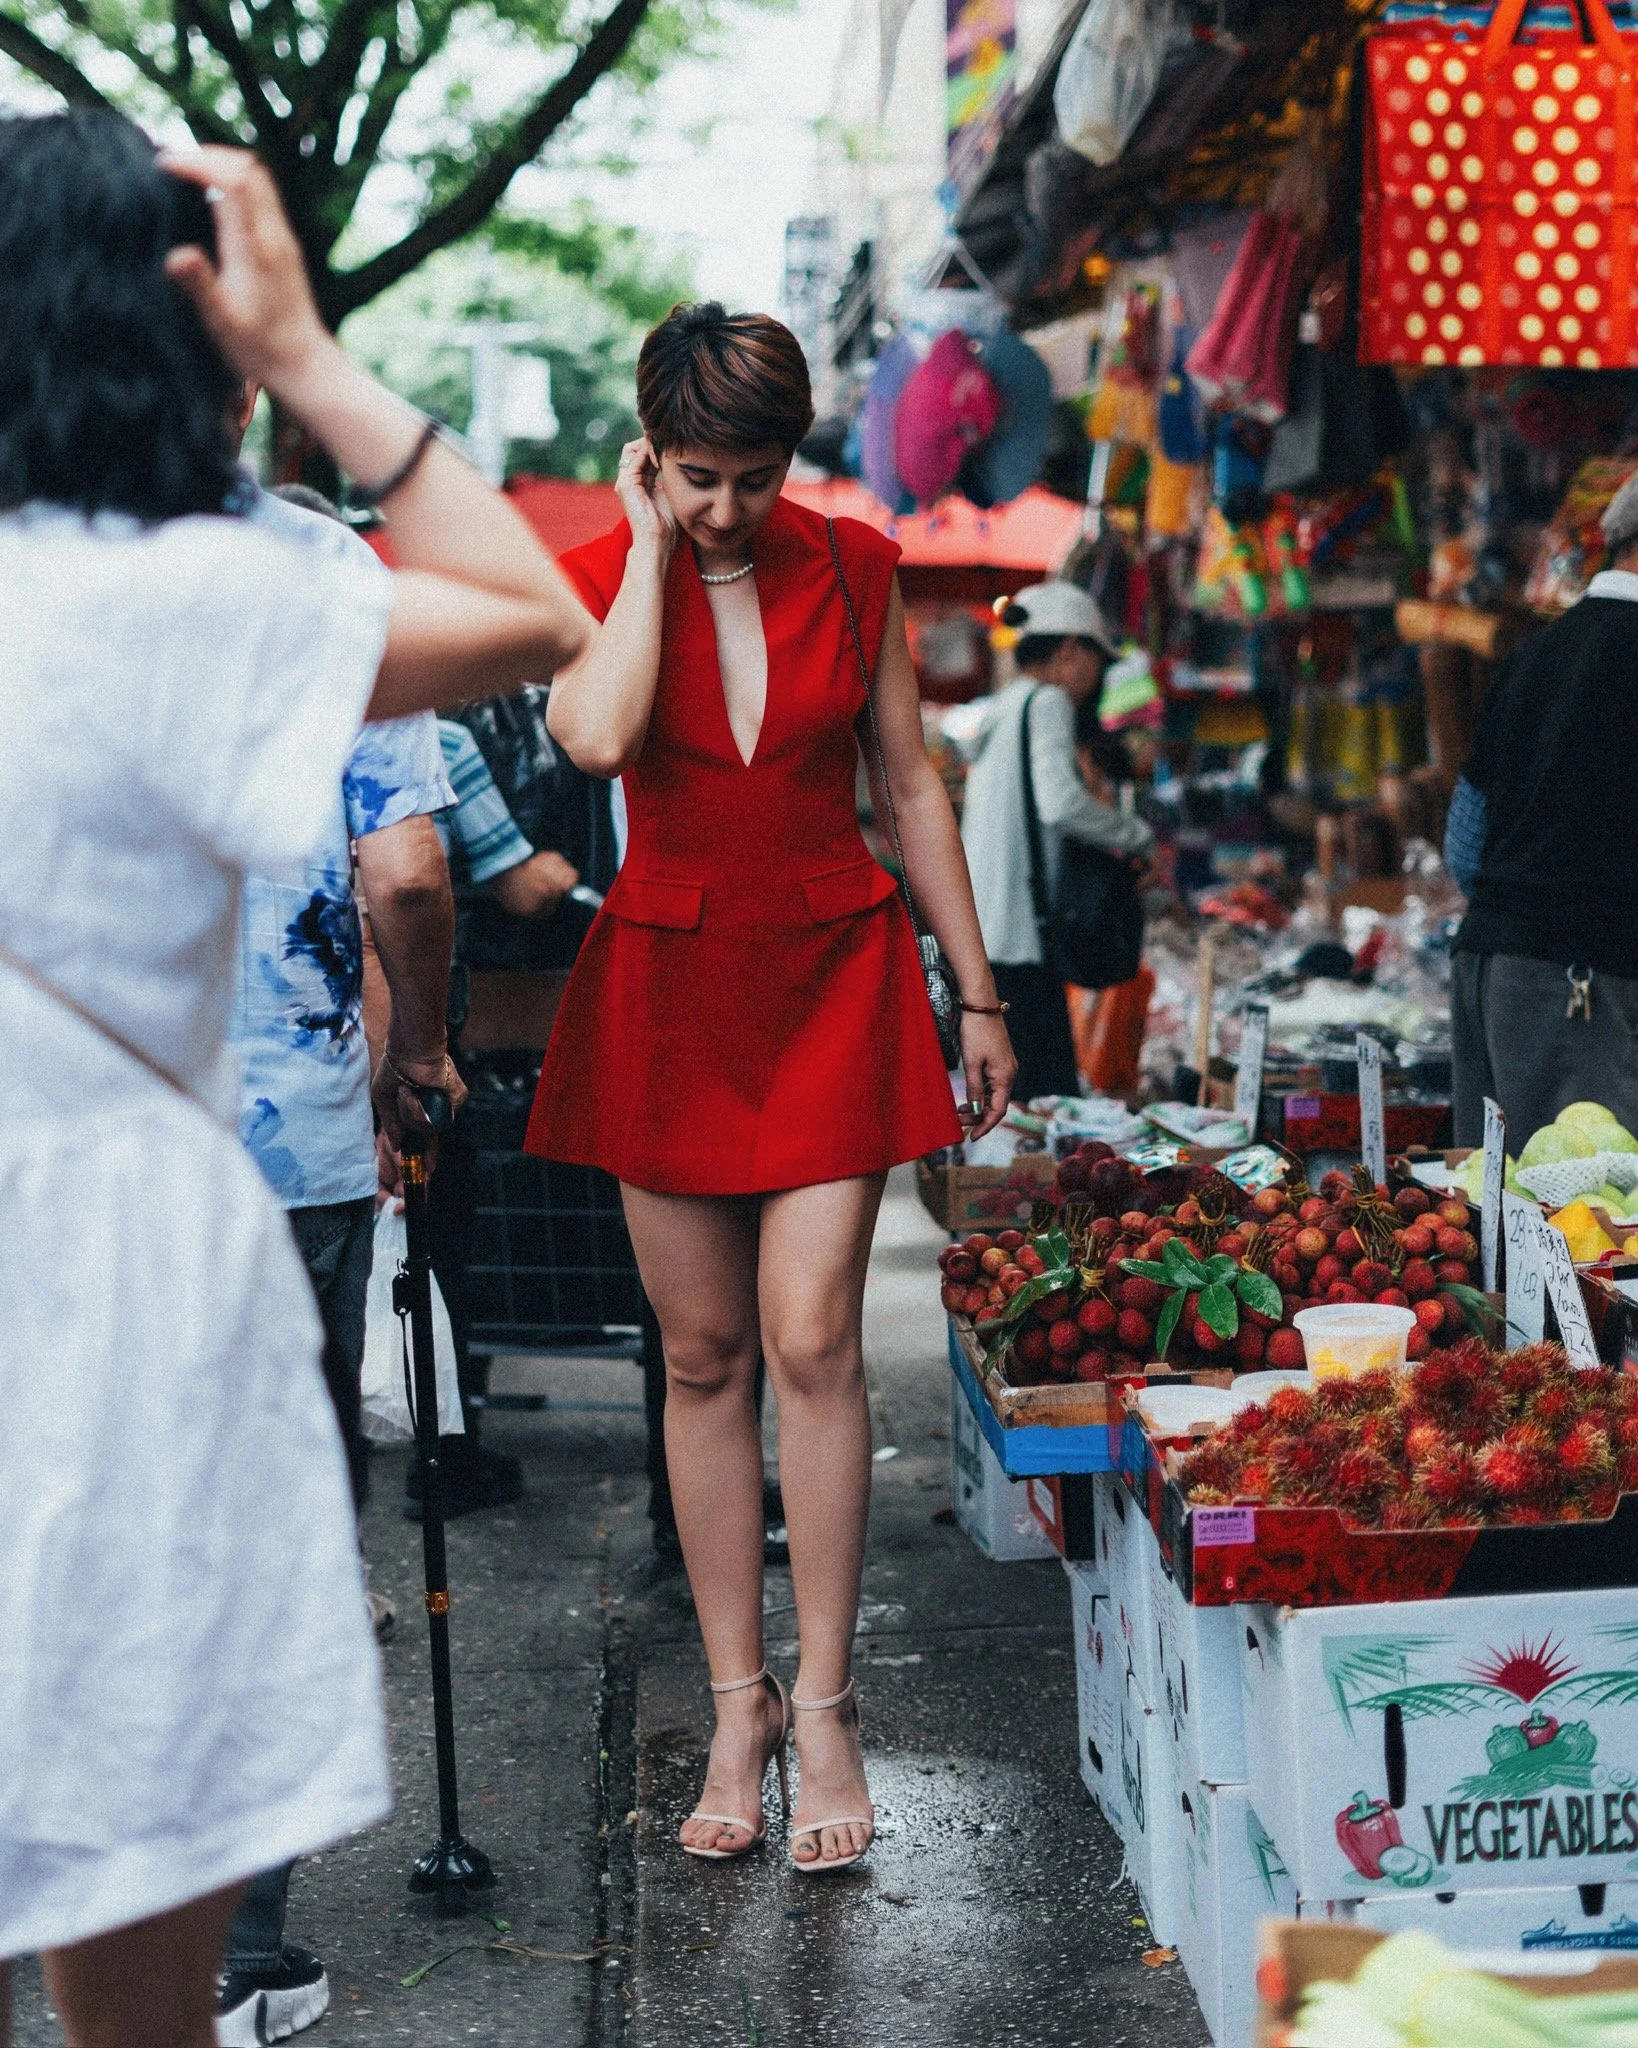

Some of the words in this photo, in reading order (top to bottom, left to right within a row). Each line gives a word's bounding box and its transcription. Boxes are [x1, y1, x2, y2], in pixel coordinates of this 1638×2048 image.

[1198, 1511, 1247, 1520] ORRI
[1226, 1576, 1234, 1589] 8
[1422, 1791, 1638, 1865] VEGETABLES
[1530, 1936, 1595, 1951] VEGETABLES
